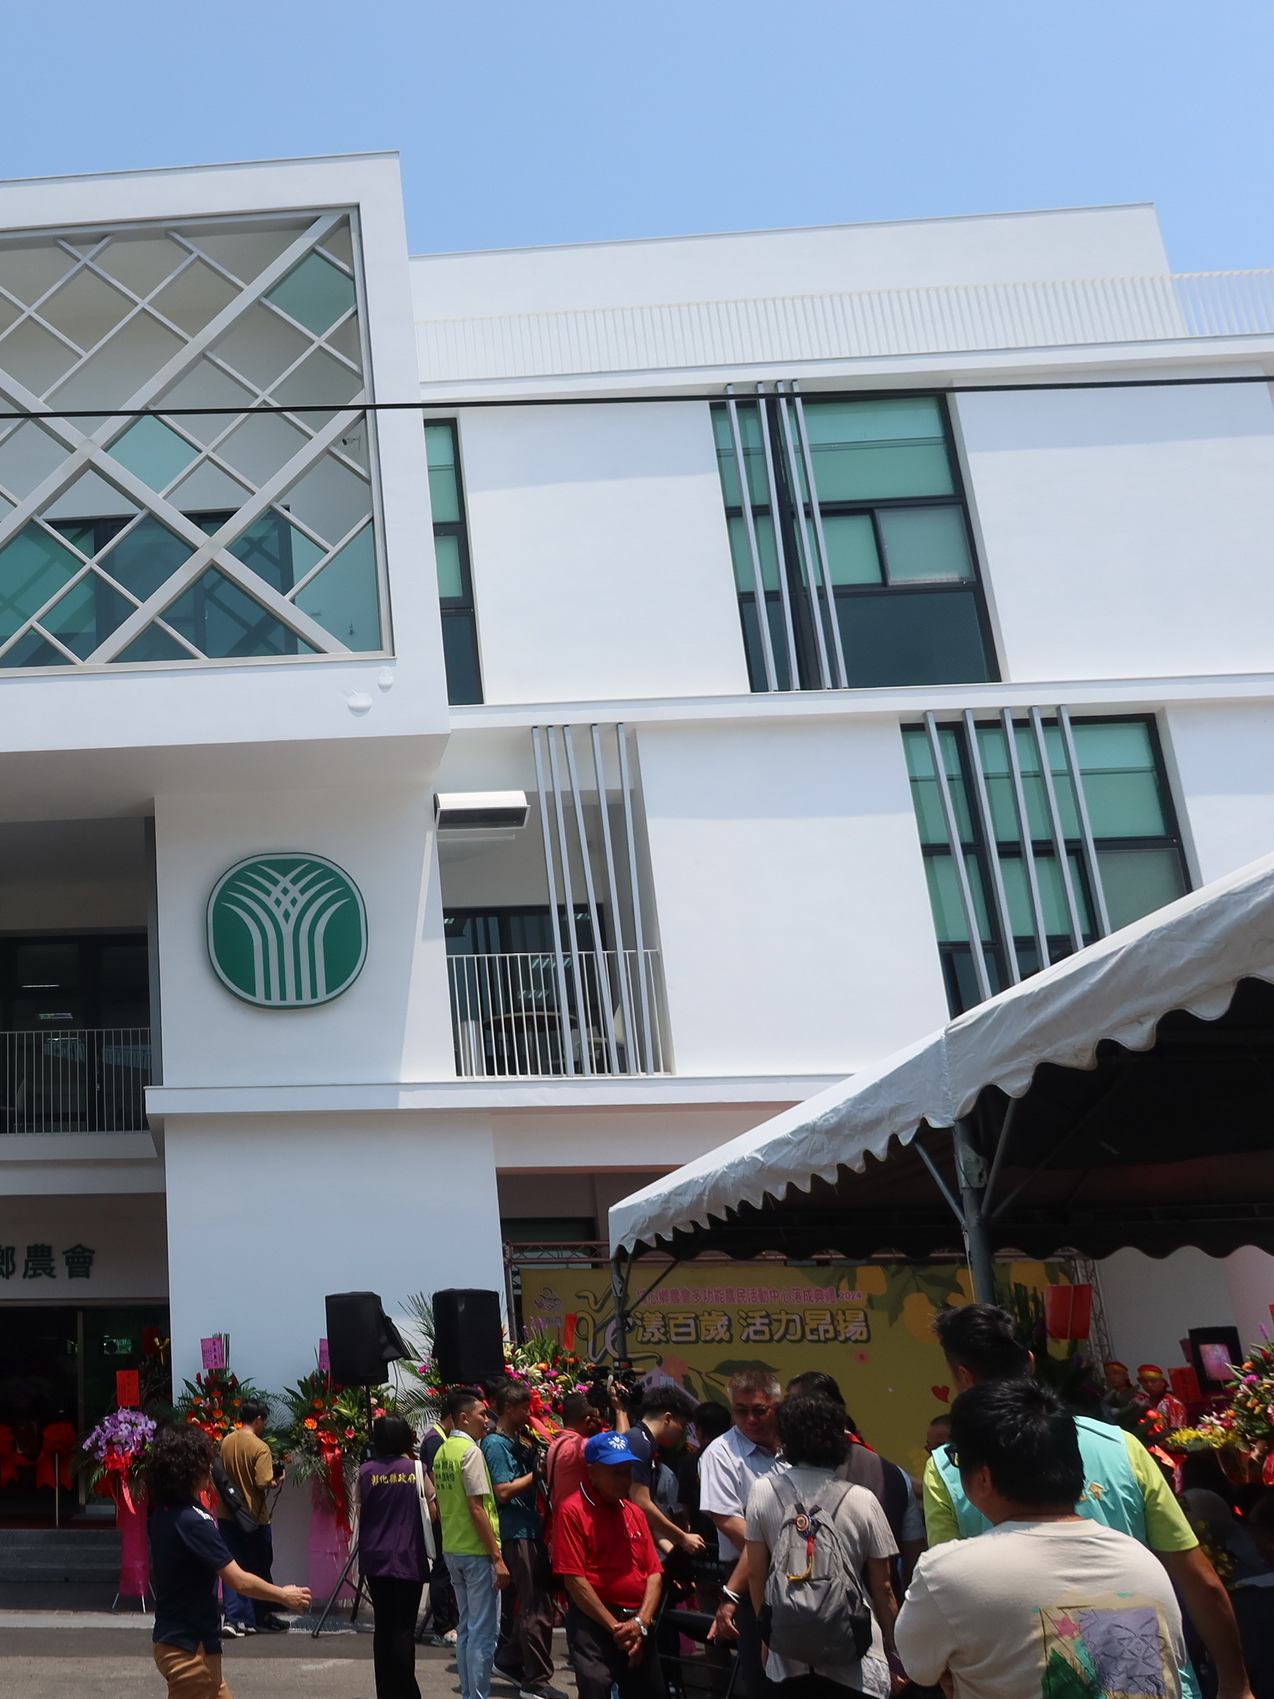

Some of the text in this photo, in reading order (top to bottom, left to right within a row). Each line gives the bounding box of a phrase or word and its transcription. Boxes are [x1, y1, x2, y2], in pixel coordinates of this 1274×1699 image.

[839, 1291, 862, 1301] 2024
[737, 1308, 871, 1344] 活力昂揚
